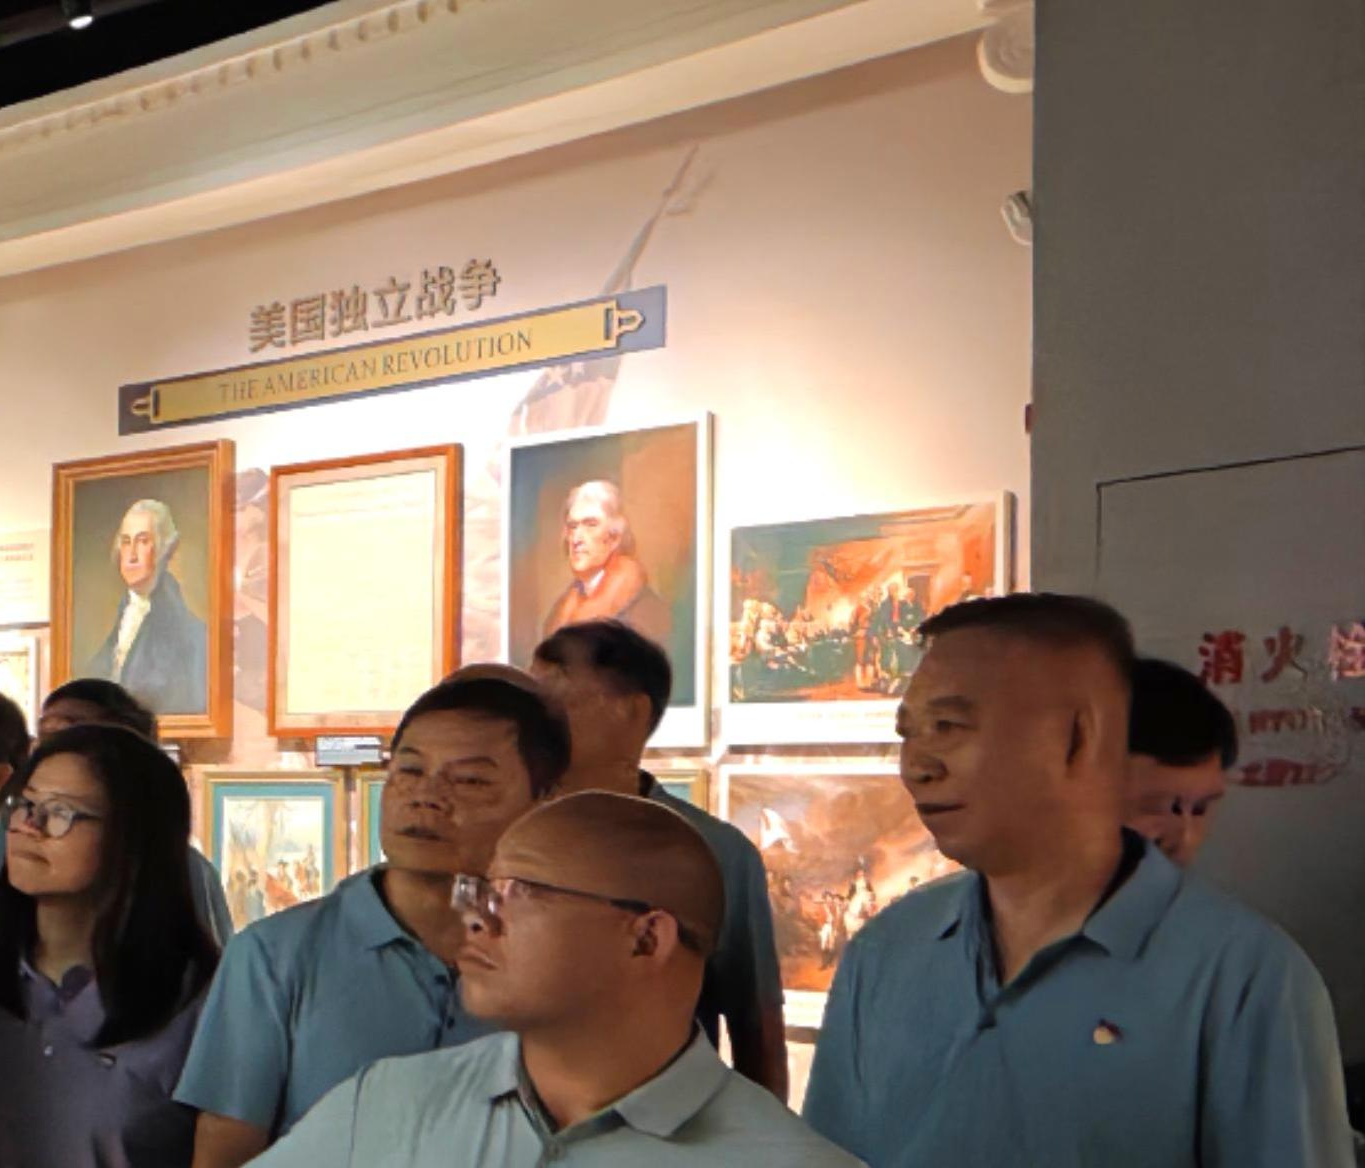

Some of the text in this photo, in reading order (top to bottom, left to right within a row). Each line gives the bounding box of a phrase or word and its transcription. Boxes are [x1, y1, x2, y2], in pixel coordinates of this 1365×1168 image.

[249, 258, 502, 354] 美国独立战争
[220, 328, 534, 405] THE AMERICAN REVOLUTION
